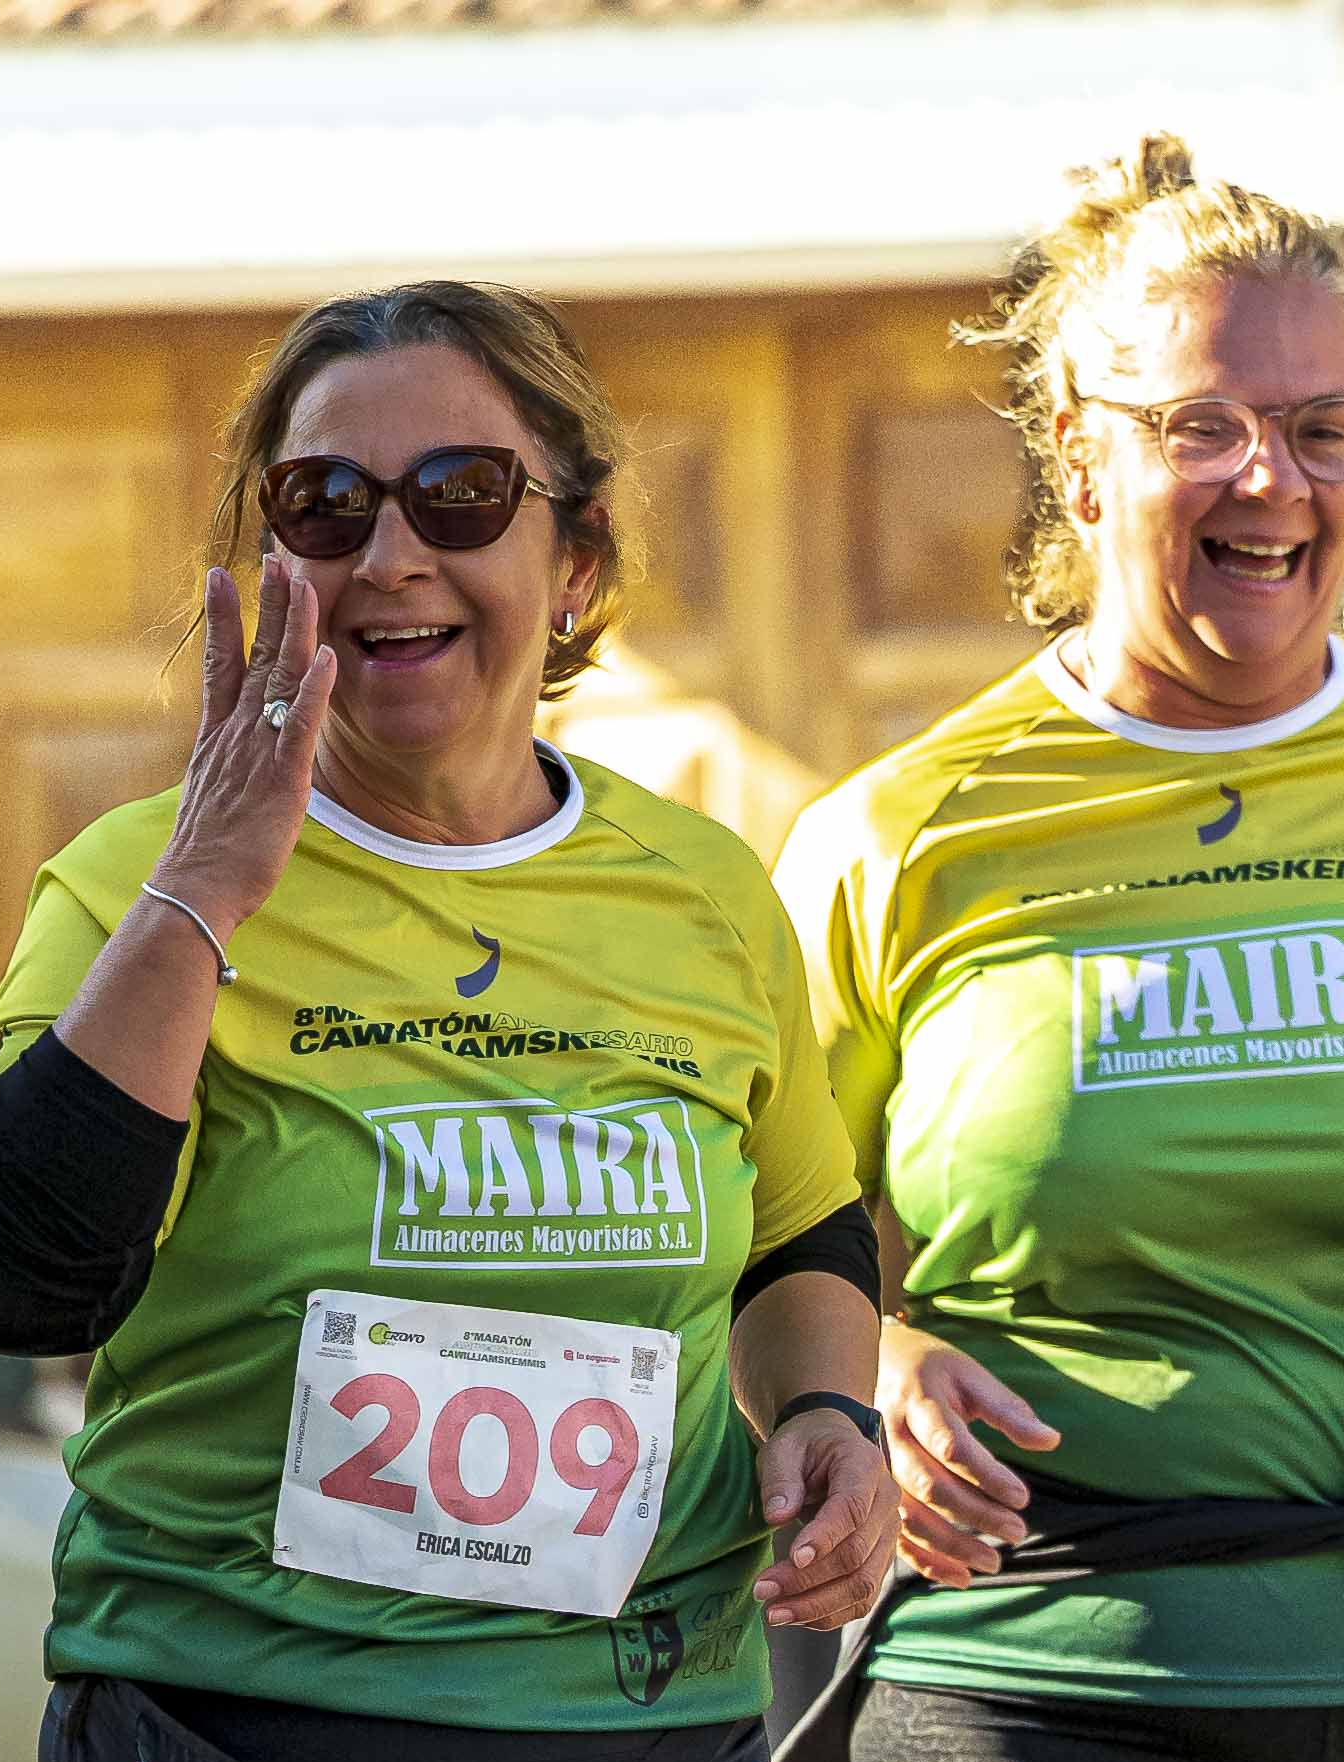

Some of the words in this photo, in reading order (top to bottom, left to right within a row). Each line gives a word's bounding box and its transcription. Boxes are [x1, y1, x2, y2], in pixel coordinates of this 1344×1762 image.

[1097, 1042, 1238, 1076] Almacenes
[389, 1111, 691, 1218] MAIRA
[393, 1224, 524, 1254] Almacenes
[531, 1224, 653, 1256] Mayoristas
[658, 1223, 693, 1250] S.A.
[318, 1373, 640, 1537] 209
[416, 1532, 461, 1556] ERICA
[465, 1539, 531, 1565] ESCALZO
